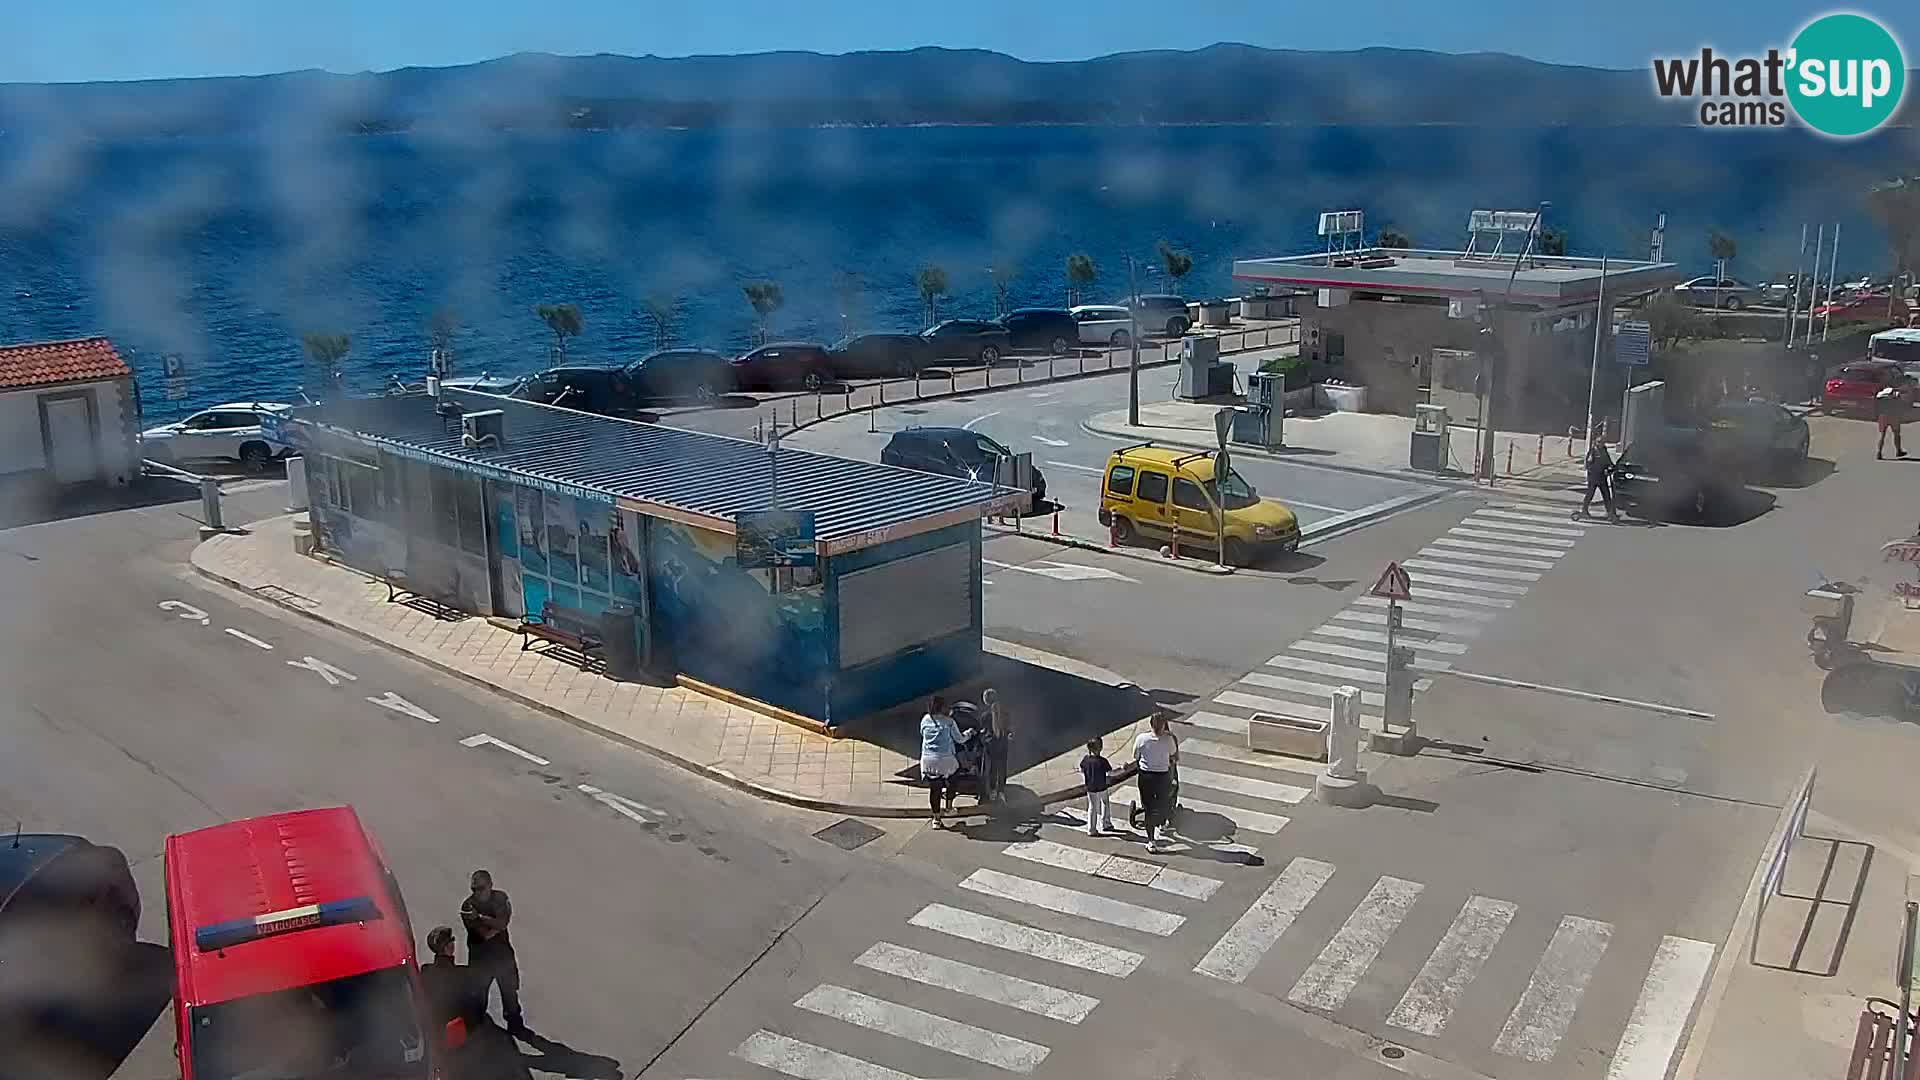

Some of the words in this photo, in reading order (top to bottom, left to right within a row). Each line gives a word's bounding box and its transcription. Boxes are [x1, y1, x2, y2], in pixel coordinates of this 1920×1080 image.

[525, 475, 557, 492] STATION
[559, 483, 585, 498] TICKET
[585, 489, 613, 504] OFFICE
